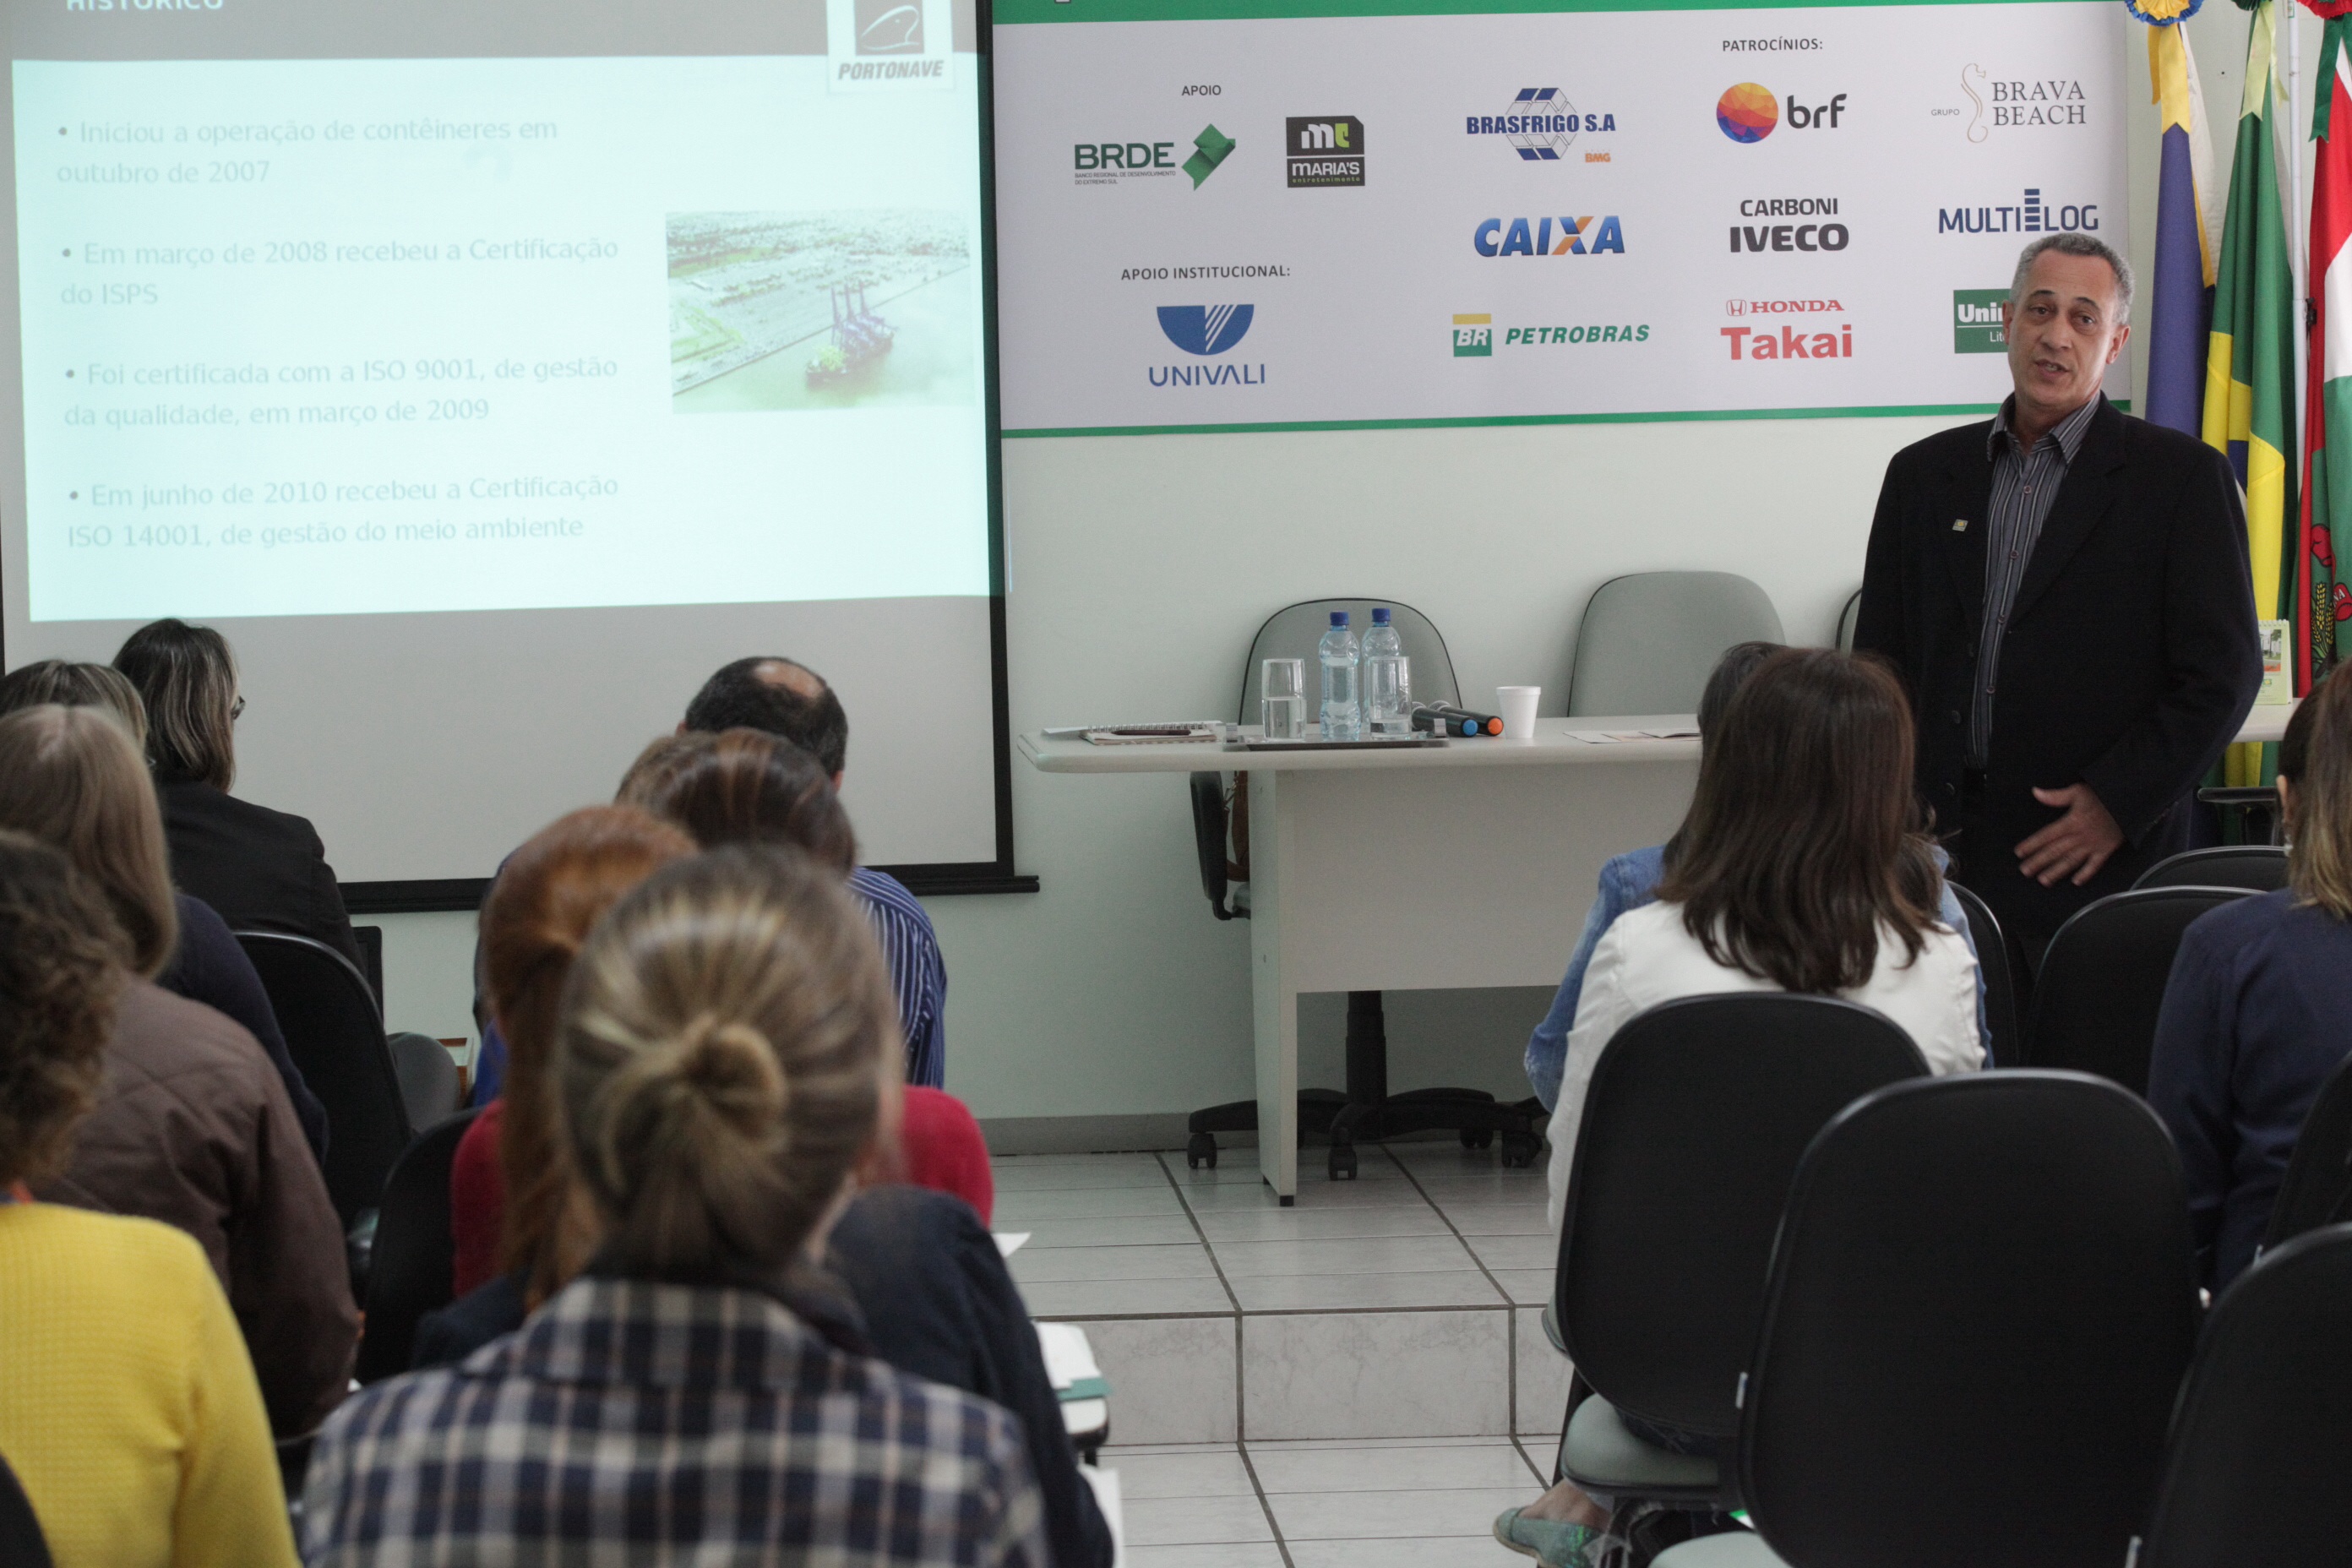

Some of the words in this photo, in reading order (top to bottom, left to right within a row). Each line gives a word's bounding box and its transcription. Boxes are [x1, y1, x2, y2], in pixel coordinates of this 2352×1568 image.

[1723, 36, 1823, 52] PATROCÍNIOS:
[838, 60, 944, 80] PORTONAVE
[1181, 84, 1222, 96] APOIO
[1991, 80, 2086, 101] BRAVA
[1787, 93, 1847, 128] brf
[1993, 106, 2087, 126] BEACH
[80, 120, 164, 144] Iniciou
[174, 126, 188, 142] a
[198, 119, 315, 147] operação
[324, 119, 355, 141] de
[363, 117, 511, 141] contêineres
[520, 122, 558, 140] em
[1467, 114, 1579, 133] BRASFRIGO
[1075, 142, 1175, 170] BRDE
[1585, 153, 1611, 163] BMG
[57, 161, 159, 184] outubro
[167, 162, 199, 183] de
[208, 161, 270, 182] 2007
[1740, 198, 1838, 216] CARBONI
[1474, 215, 1625, 257] CAIXA
[1730, 224, 1849, 253] IVECO
[84, 242, 125, 264] Em
[135, 245, 213, 269] março
[223, 242, 255, 264] de
[264, 241, 327, 263] 2008
[335, 241, 438, 262] recebeu
[446, 243, 461, 261] a
[470, 237, 618, 264] Certificação
[1121, 268, 1168, 280] APOIO
[1173, 265, 1291, 279] INSTITUCIONAL:
[61, 283, 92, 305] do
[101, 283, 158, 305] ISPS
[1750, 300, 1844, 313] HONDA
[1958, 302, 2003, 323] Uni
[1456, 329, 1489, 346] BR
[1505, 324, 1650, 345] PETROBRAS
[1721, 324, 1852, 360] Takai
[89, 363, 124, 385] Foi
[134, 362, 270, 385] certificada
[279, 365, 330, 383] com
[340, 365, 355, 382] a
[363, 359, 406, 381] ISO
[416, 359, 486, 381] 9001,
[495, 358, 525, 378] de
[534, 357, 618, 383] gestão
[1149, 364, 1265, 387] UNIVALI
[64, 406, 95, 426] da
[106, 404, 240, 430] qualidade,
[250, 406, 290, 423] em
[298, 404, 377, 427] março
[386, 400, 416, 421] de
[427, 399, 490, 421] 2009
[92, 484, 132, 506] Em
[142, 483, 214, 510] junho
[222, 482, 253, 504] de
[264, 482, 327, 504] 2010
[336, 480, 437, 502] recebeu
[446, 482, 460, 498] a
[470, 476, 618, 500] Certificação
[68, 525, 112, 547] ISO
[124, 524, 211, 548] 14001,
[221, 523, 252, 545] de
[261, 521, 347, 549] gestão
[356, 520, 386, 542] do
[395, 519, 456, 541] meio
[466, 516, 584, 538] ambiente
